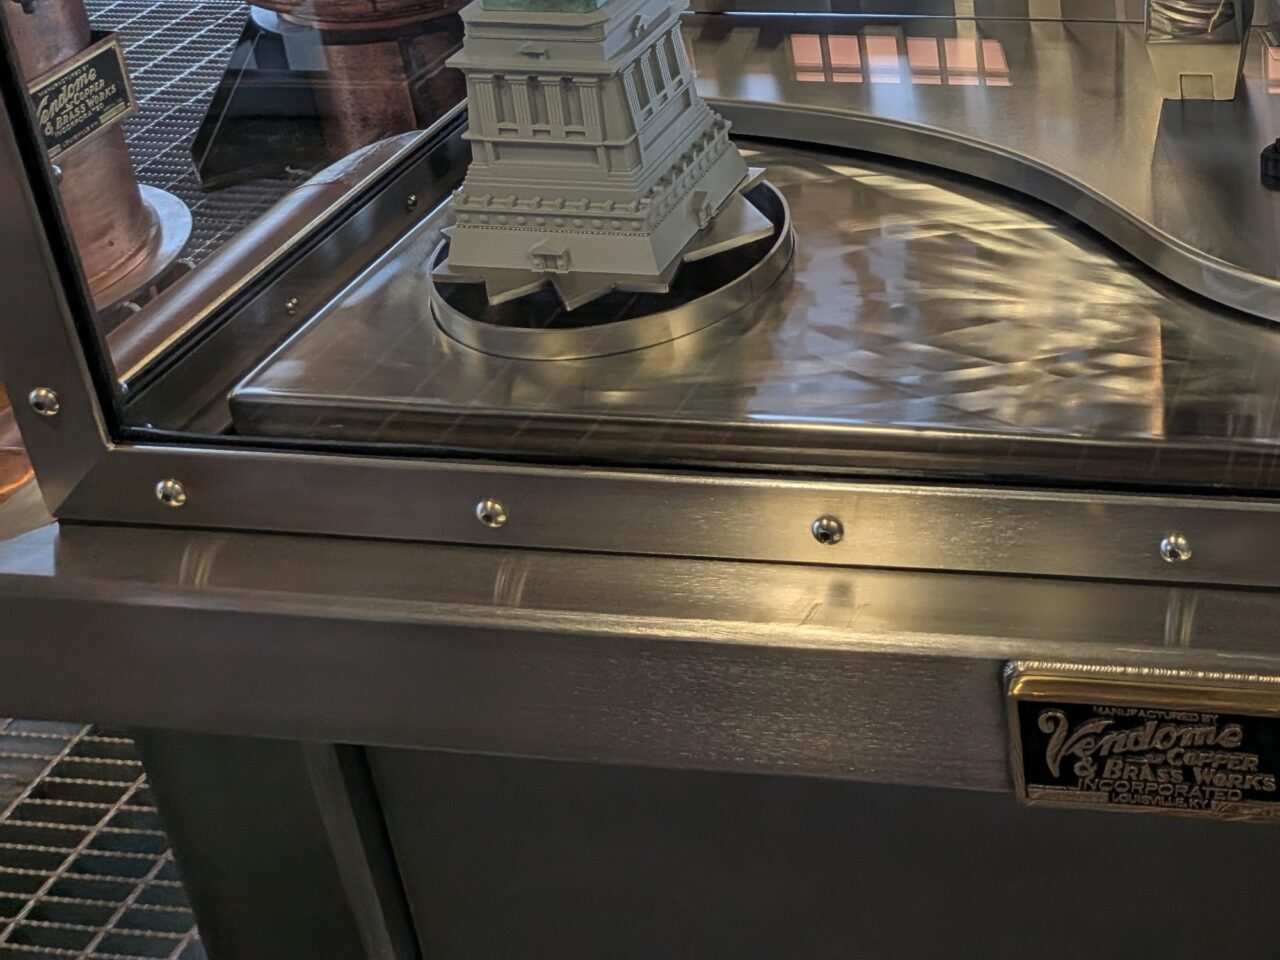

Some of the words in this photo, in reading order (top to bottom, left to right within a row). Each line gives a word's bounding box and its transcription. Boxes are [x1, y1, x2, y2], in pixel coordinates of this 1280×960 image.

[74, 78, 105, 104] COPPER
[56, 102, 86, 130] BRASS
[87, 83, 118, 108] WORKS
[1093, 705, 1198, 722] MANUFACTURED
[1201, 713, 1219, 724] BY
[1038, 708, 1244, 778] Vendome
[1166, 747, 1259, 772] COPPER
[1073, 756, 1098, 777] &
[1103, 759, 1184, 784] BRASS
[1194, 767, 1278, 792] WORKS
[1077, 777, 1243, 802] INCORPORATED
